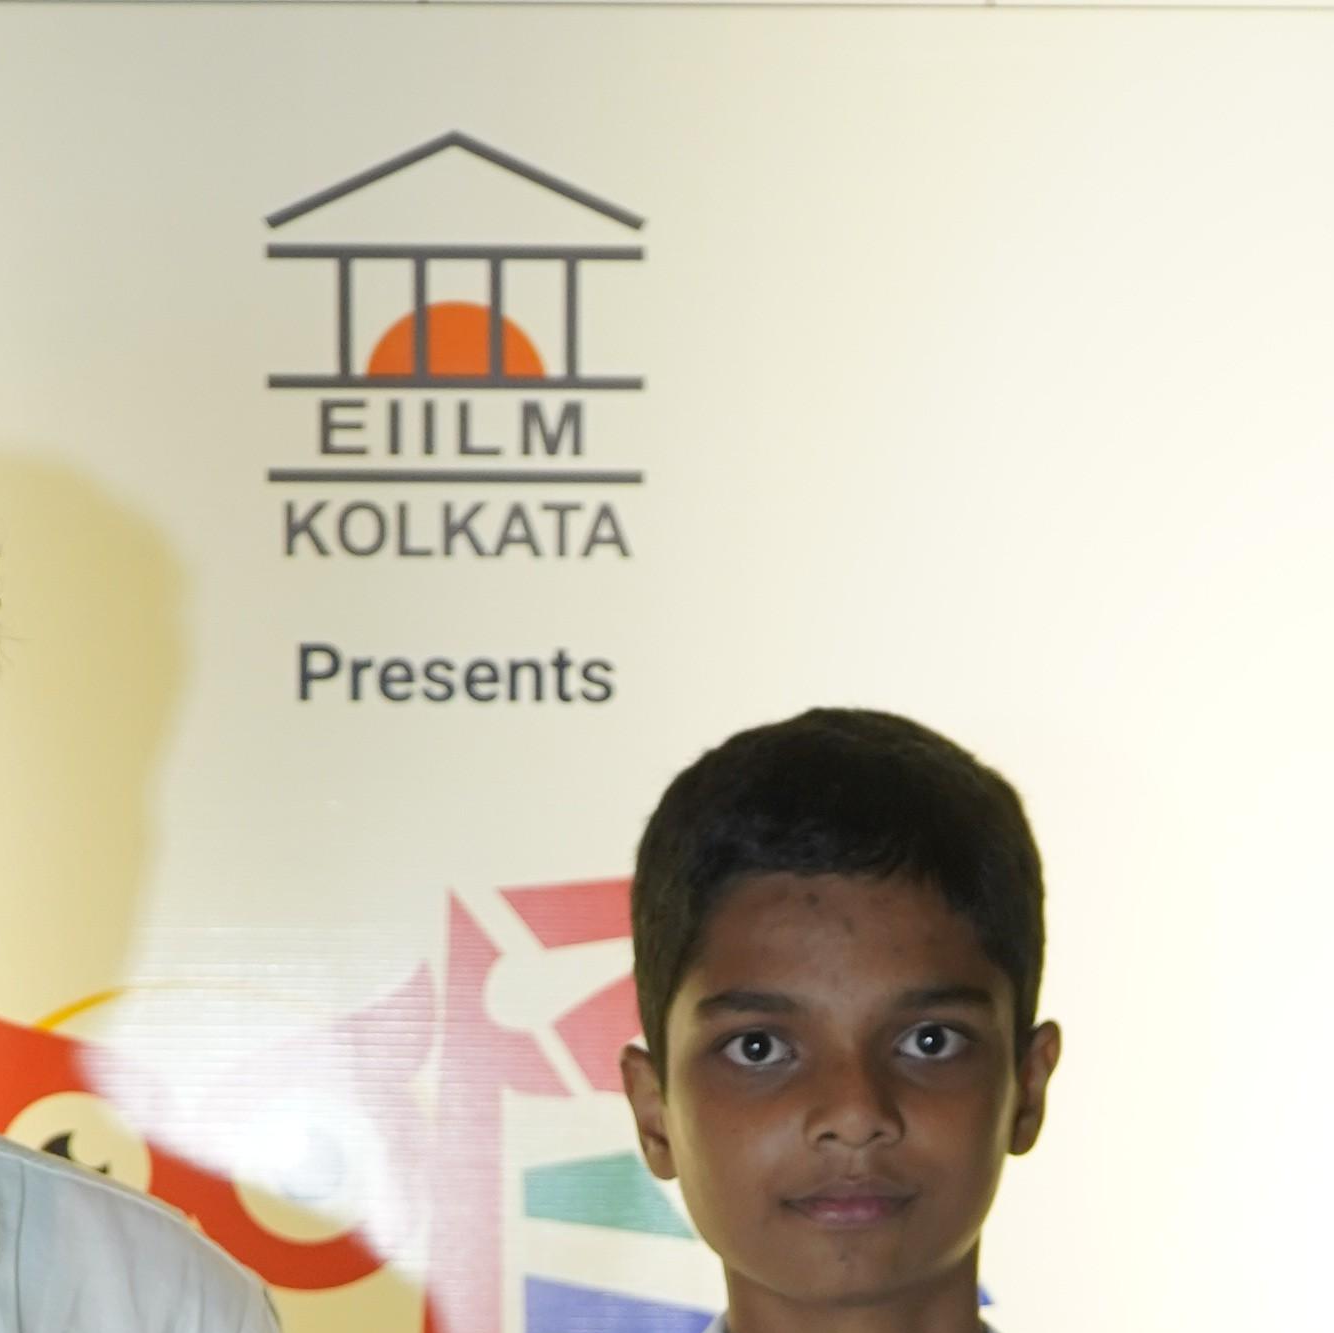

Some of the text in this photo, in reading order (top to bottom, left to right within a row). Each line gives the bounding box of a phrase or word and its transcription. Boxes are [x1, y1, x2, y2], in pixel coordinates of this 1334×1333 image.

[319, 399, 585, 457] EIILM
[284, 500, 632, 559] KOLKATA
[297, 642, 617, 703] Presents
